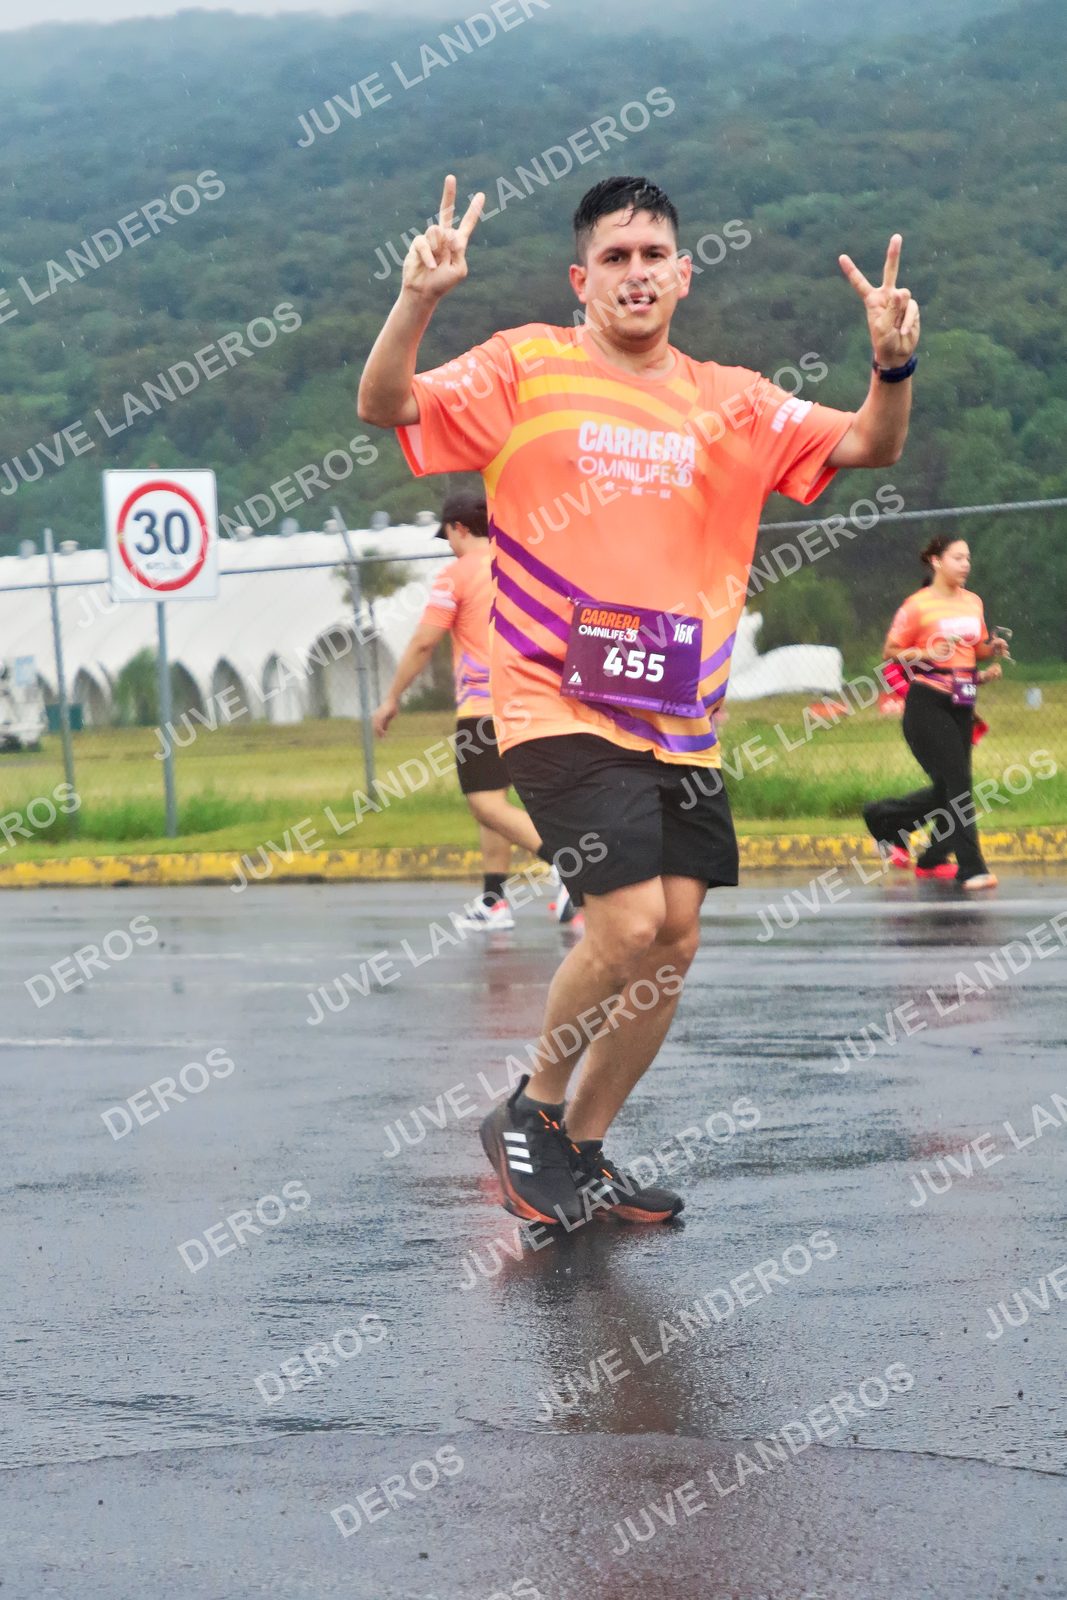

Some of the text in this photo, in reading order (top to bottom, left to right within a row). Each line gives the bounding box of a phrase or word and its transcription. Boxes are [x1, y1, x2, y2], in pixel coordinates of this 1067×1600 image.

[578, 420, 696, 464] CARRERA
[133, 508, 191, 556] 30
[580, 608, 640, 630] CARRERA
[602, 647, 666, 683] 455
